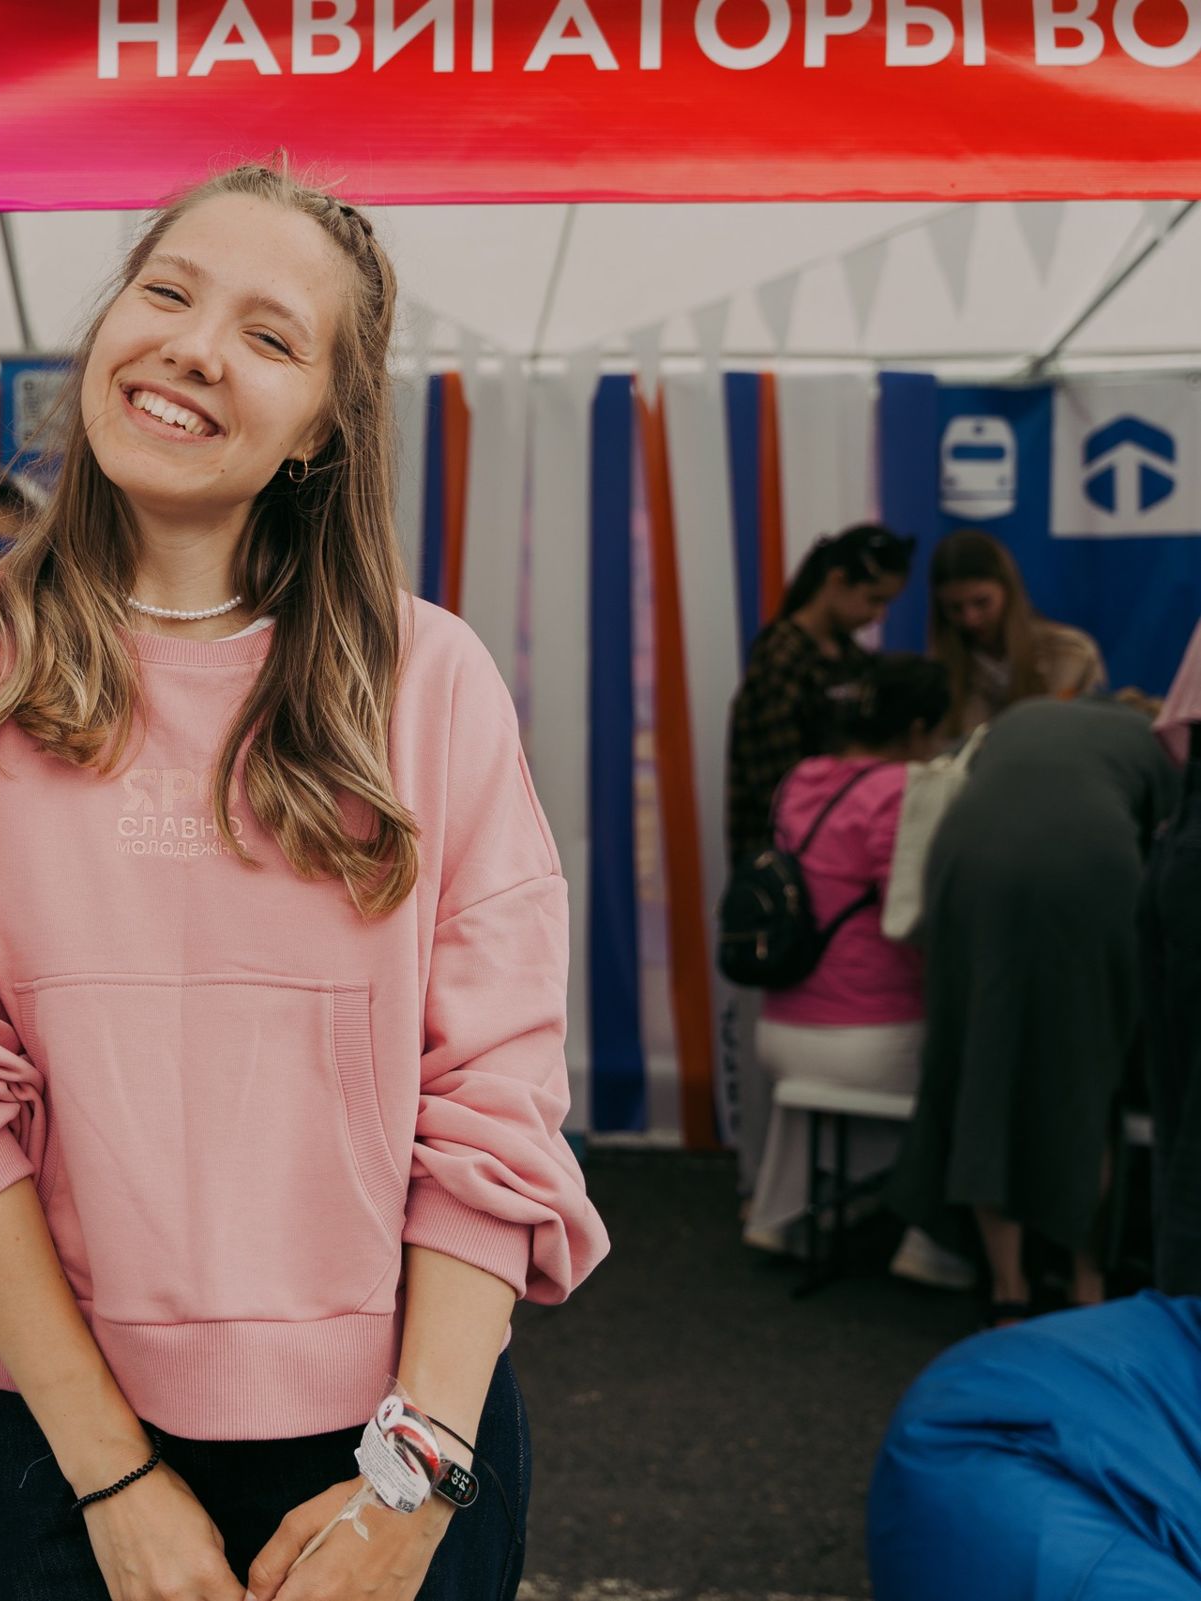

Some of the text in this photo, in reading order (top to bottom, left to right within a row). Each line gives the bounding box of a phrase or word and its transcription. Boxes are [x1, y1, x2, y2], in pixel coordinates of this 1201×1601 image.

[1032, 0, 1201, 67] ВО
[117, 815, 244, 840] СЛАВНО
[451, 1468, 462, 1485] 29
[459, 1474, 470, 1492] 14
